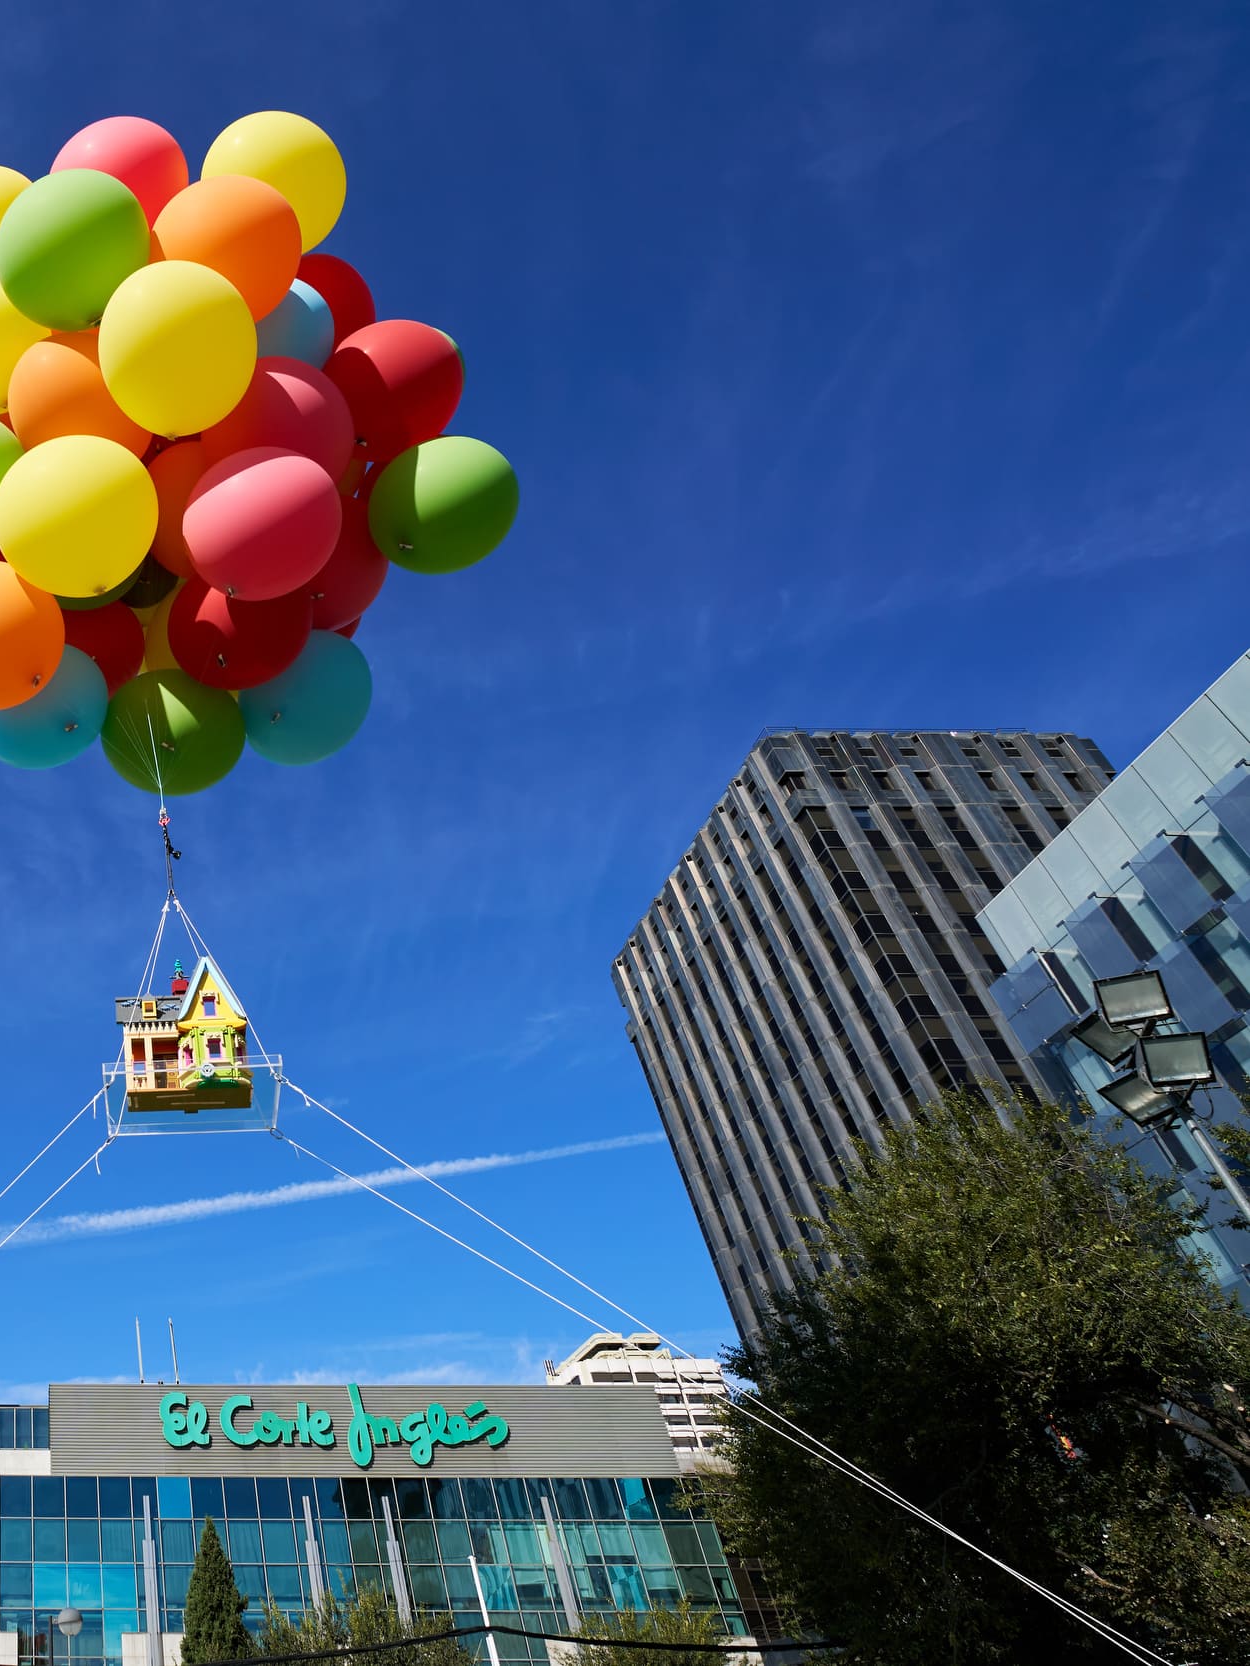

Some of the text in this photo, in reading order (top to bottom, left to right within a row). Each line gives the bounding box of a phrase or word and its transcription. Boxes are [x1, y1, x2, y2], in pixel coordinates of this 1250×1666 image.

[159, 1383, 508, 1468] El Corte Inglés
